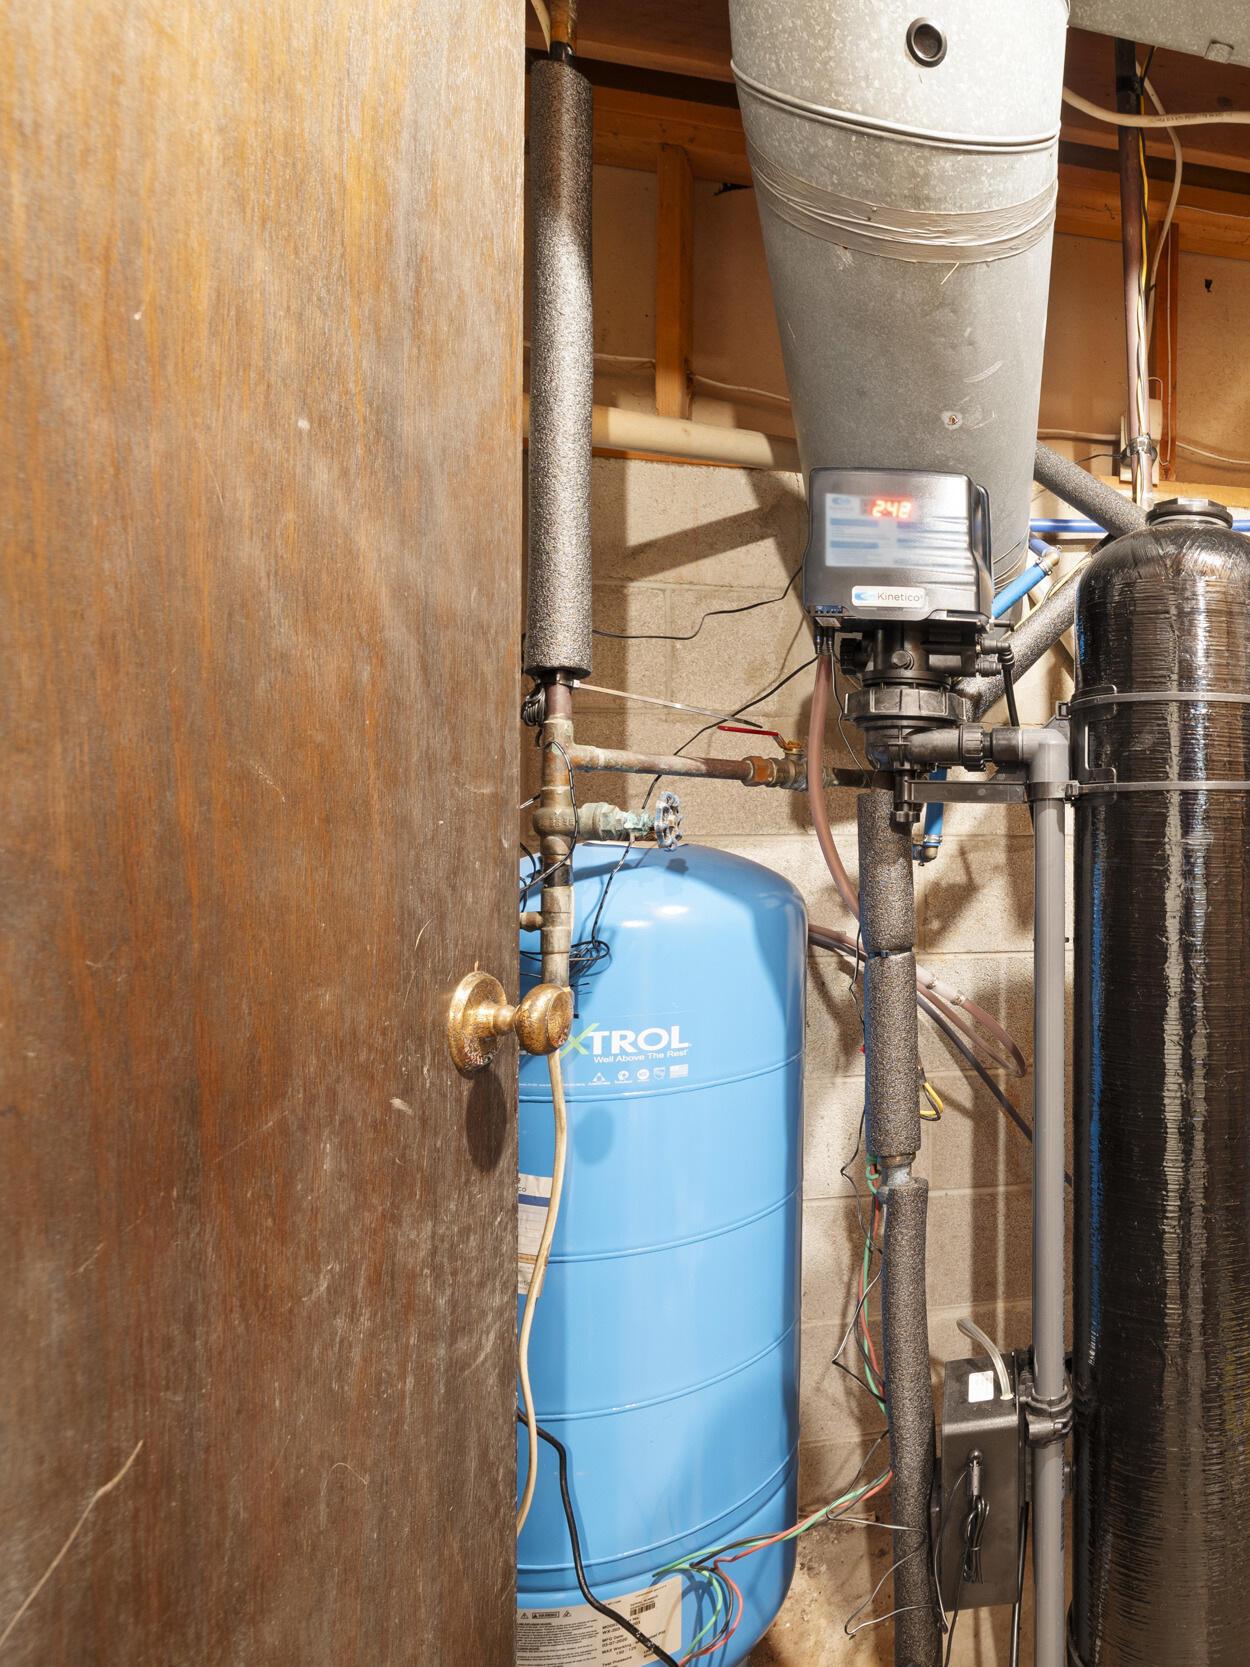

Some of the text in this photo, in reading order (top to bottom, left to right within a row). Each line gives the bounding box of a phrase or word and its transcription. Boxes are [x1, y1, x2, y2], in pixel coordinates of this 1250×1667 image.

[877, 592, 920, 602] Kinetico
[593, 1049, 688, 1064] Well Above The Rest
